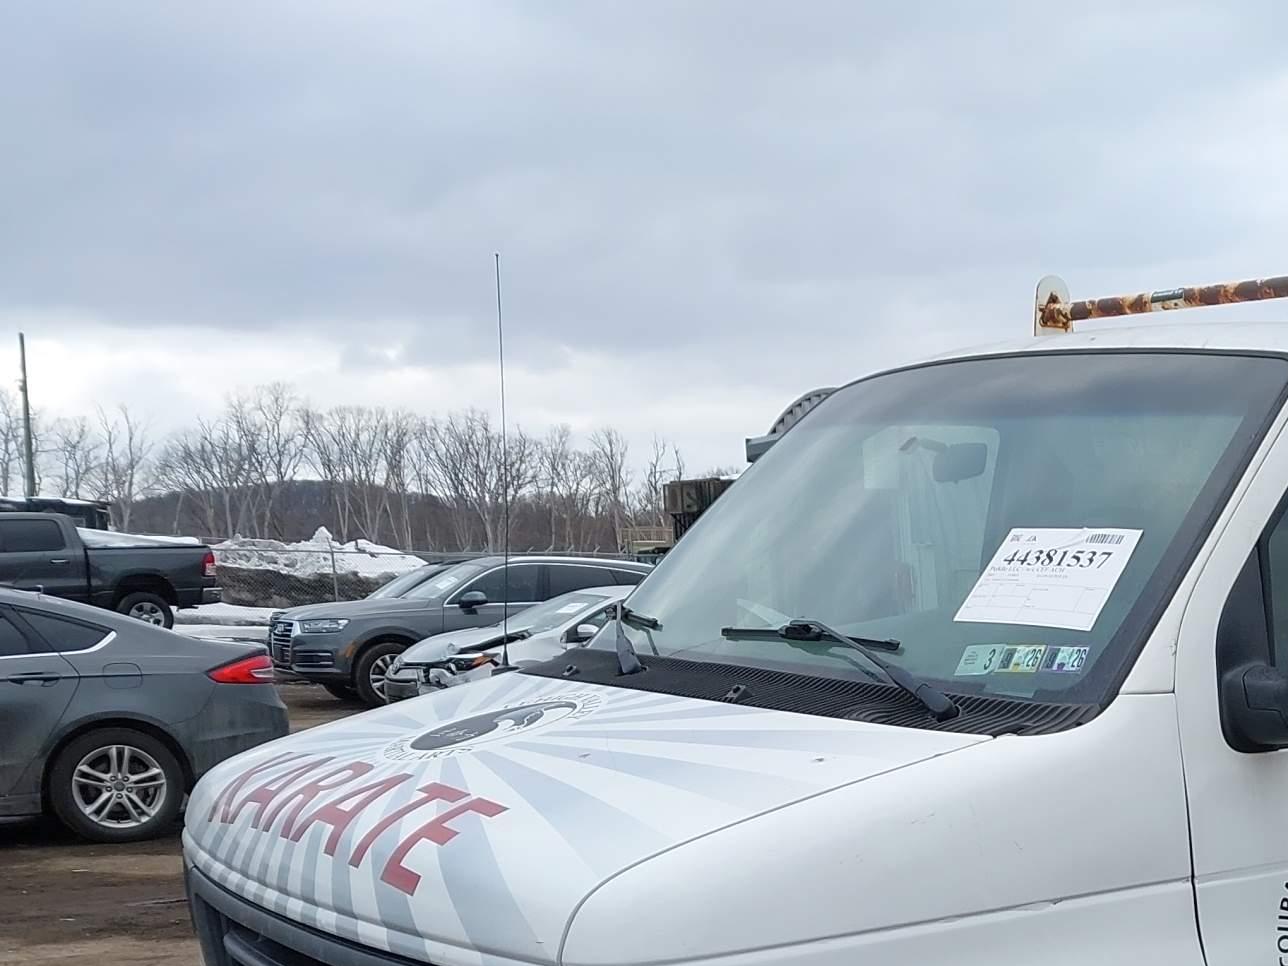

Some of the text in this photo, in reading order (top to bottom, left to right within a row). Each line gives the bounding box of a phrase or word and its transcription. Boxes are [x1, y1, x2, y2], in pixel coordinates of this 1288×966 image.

[1003, 549, 1114, 569] 44381537
[983, 648, 996, 670] 3
[1025, 648, 1041, 668] 26
[1071, 648, 1086, 668] 26
[207, 750, 509, 896] KARATE
